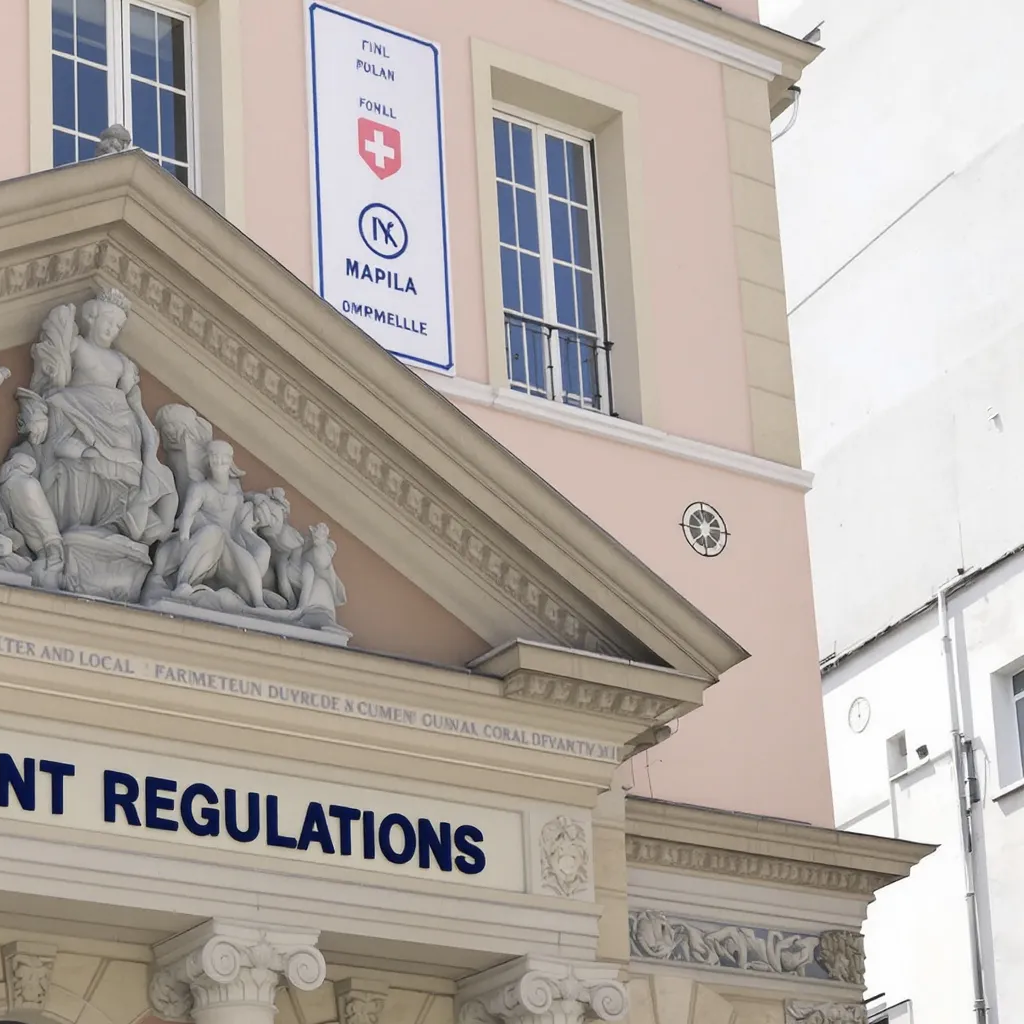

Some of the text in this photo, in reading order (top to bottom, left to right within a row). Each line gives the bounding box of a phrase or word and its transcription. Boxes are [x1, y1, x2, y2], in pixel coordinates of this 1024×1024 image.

[346, 258, 417, 295] MAPILA
[40, 646, 75, 663] AND
[79, 652, 135, 674] LOCAL
[103, 769, 486, 874] REGULATIONS
